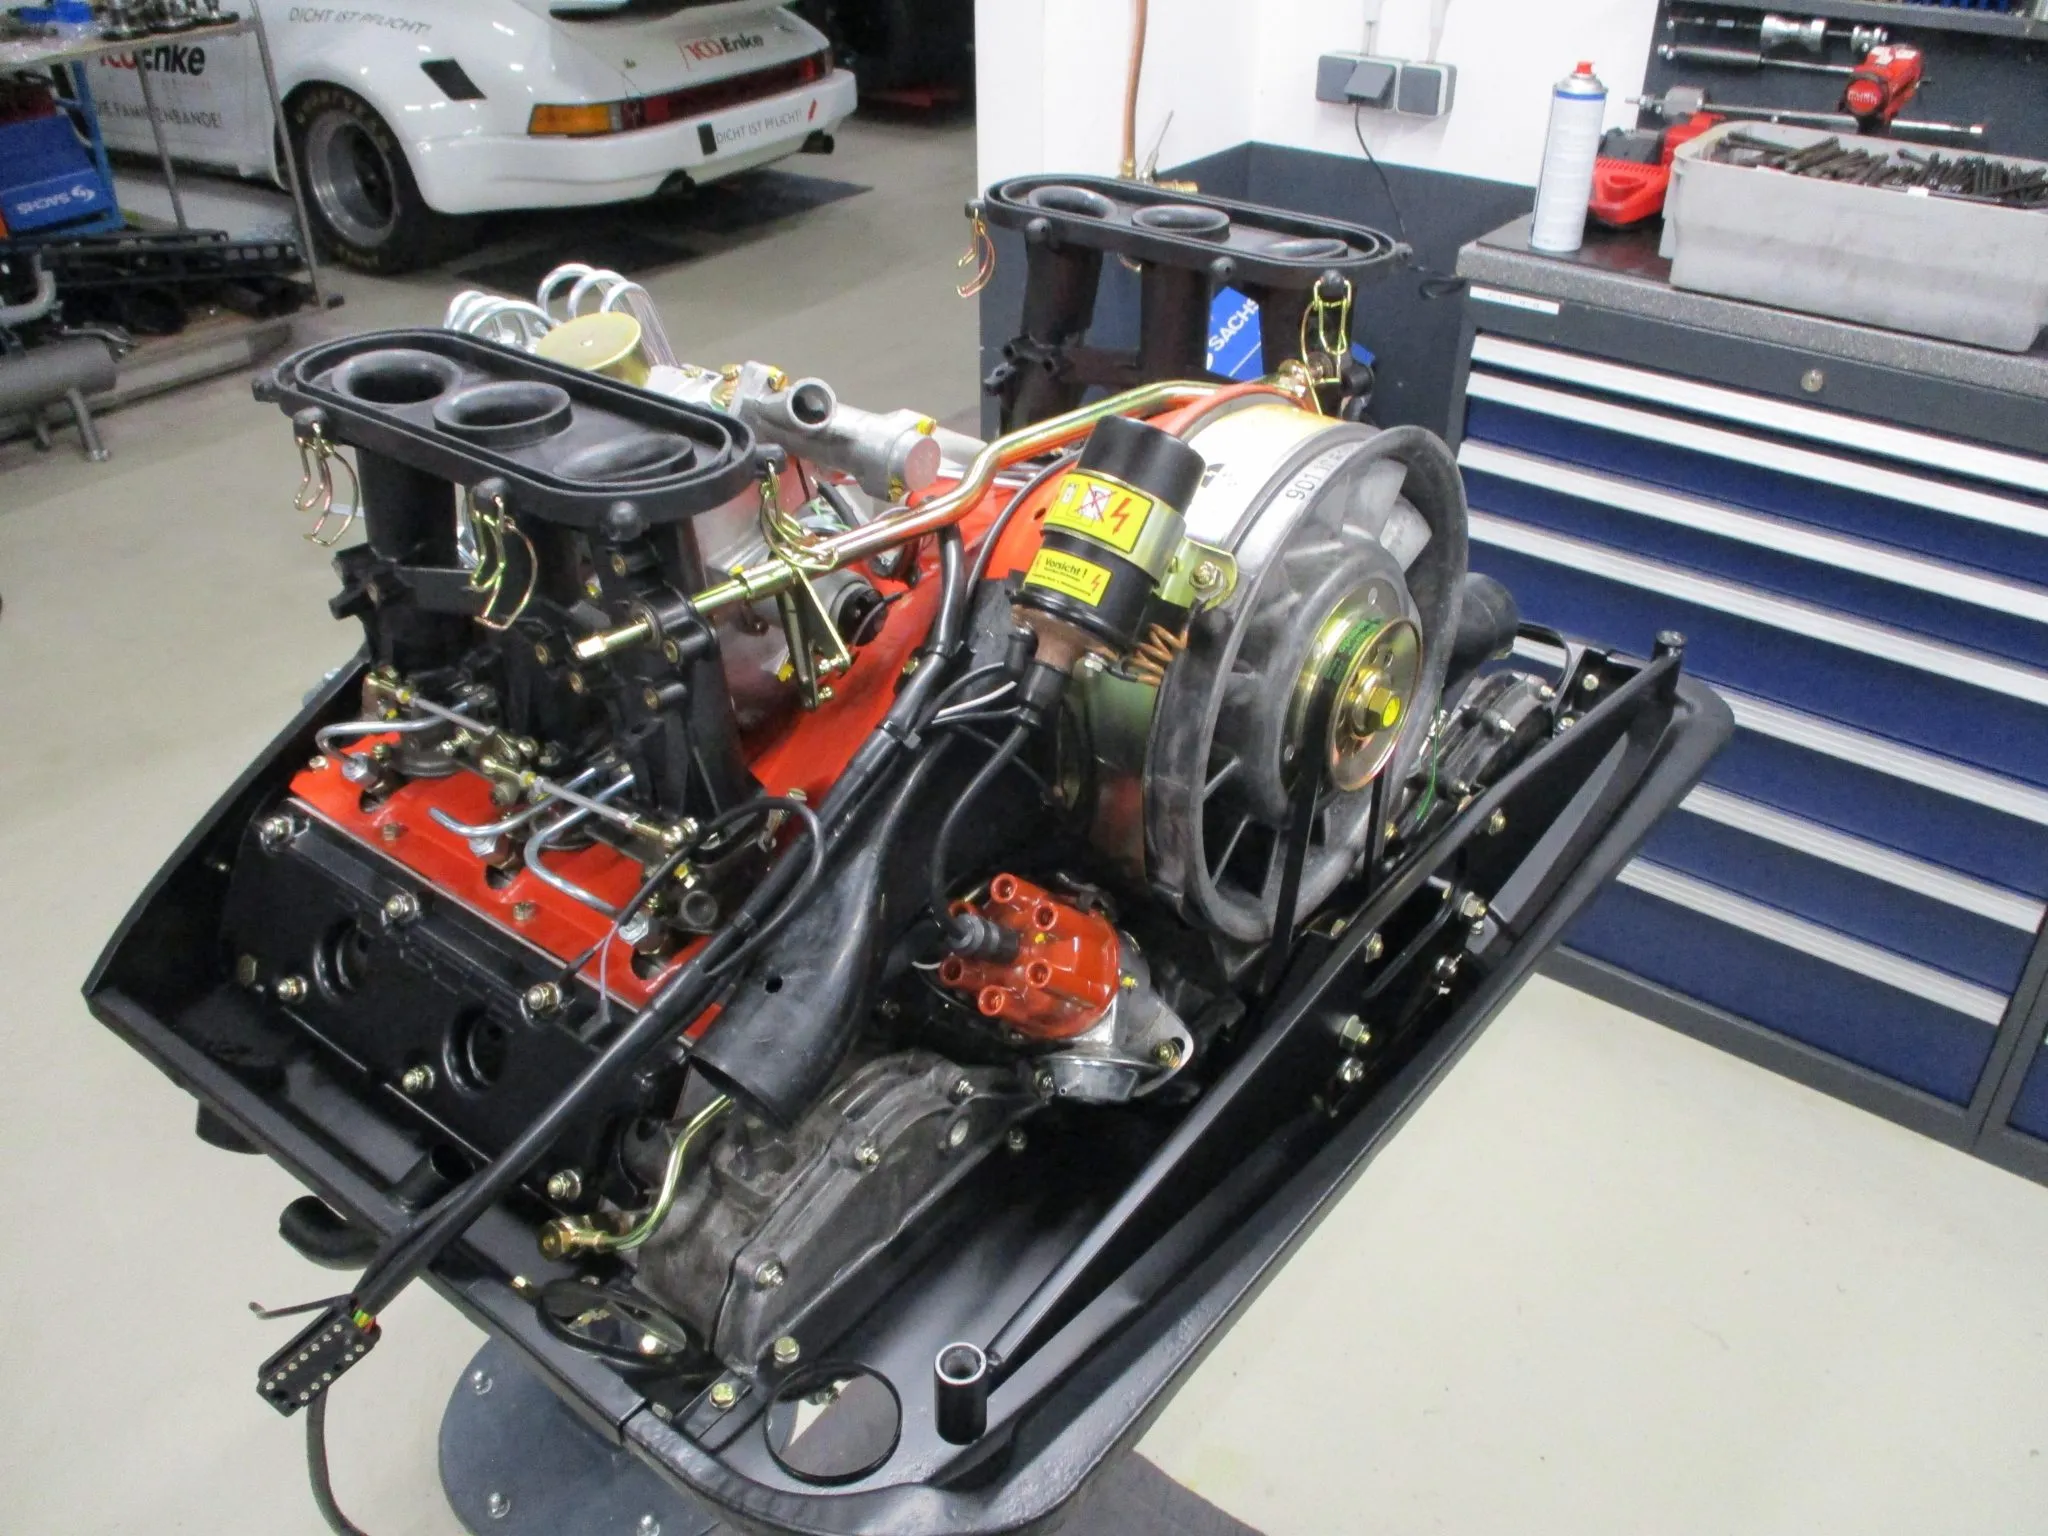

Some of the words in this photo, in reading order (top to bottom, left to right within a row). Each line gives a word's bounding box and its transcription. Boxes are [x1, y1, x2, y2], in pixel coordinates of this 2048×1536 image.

[289, 7, 334, 23] DICHT
[715, 126, 747, 145] DICHT
[747, 120, 764, 137] IST
[1045, 557, 1081, 576] Vorsicht
